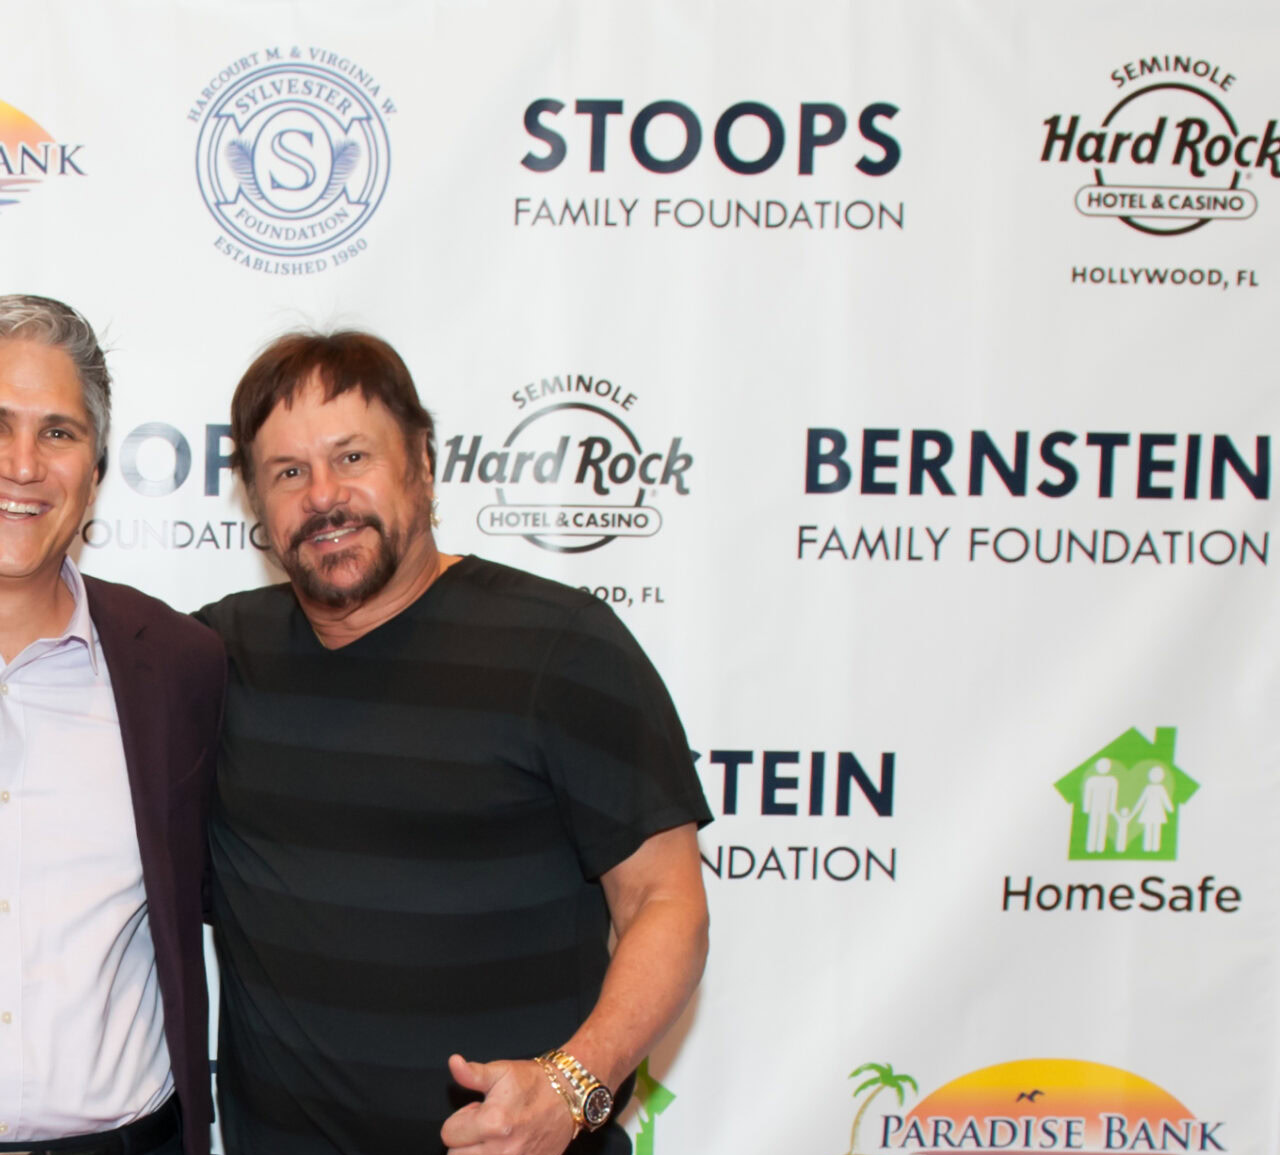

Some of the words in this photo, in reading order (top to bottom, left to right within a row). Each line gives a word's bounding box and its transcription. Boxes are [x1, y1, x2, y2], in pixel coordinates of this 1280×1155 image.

[188, 51, 259, 122] HARCOURT
[290, 46, 301, 58] &
[309, 47, 381, 98] VIRGINIA
[1111, 55, 1236, 92] SEMINOLE
[235, 79, 353, 115] SYLVESTER
[520, 98, 902, 178] STOOPS
[1040, 114, 1167, 164] Hard
[1172, 117, 1280, 178] Rock
[515, 198, 639, 227] FAMILY
[655, 198, 904, 230] FOUNDATION
[1087, 193, 1146, 208] HOTEL
[1152, 194, 1165, 209] &
[1168, 194, 1244, 211] CASINO
[234, 207, 350, 241] FOUNDATION
[213, 236, 327, 275] ESTABLISHED
[332, 238, 368, 267] 1980
[1072, 267, 1229, 290] HOLLYWOOD,
[1237, 270, 1258, 287] FL
[512, 374, 638, 411] SEMINOLE
[442, 435, 571, 484] Hard
[575, 436, 693, 496] Rock
[804, 427, 1271, 501] BERNSTEIN
[490, 512, 550, 527] HOTEL
[556, 512, 569, 528] &
[573, 512, 649, 529] CASINO
[797, 525, 950, 562] FAMILY
[969, 527, 1270, 566] FOUNDATION
[642, 587, 664, 603] FL
[701, 846, 896, 881] NDATION
[1002, 875, 1242, 914] HomeSafe
[881, 1115, 1082, 1149] PARADISE
[1105, 1116, 1227, 1151] BANK
